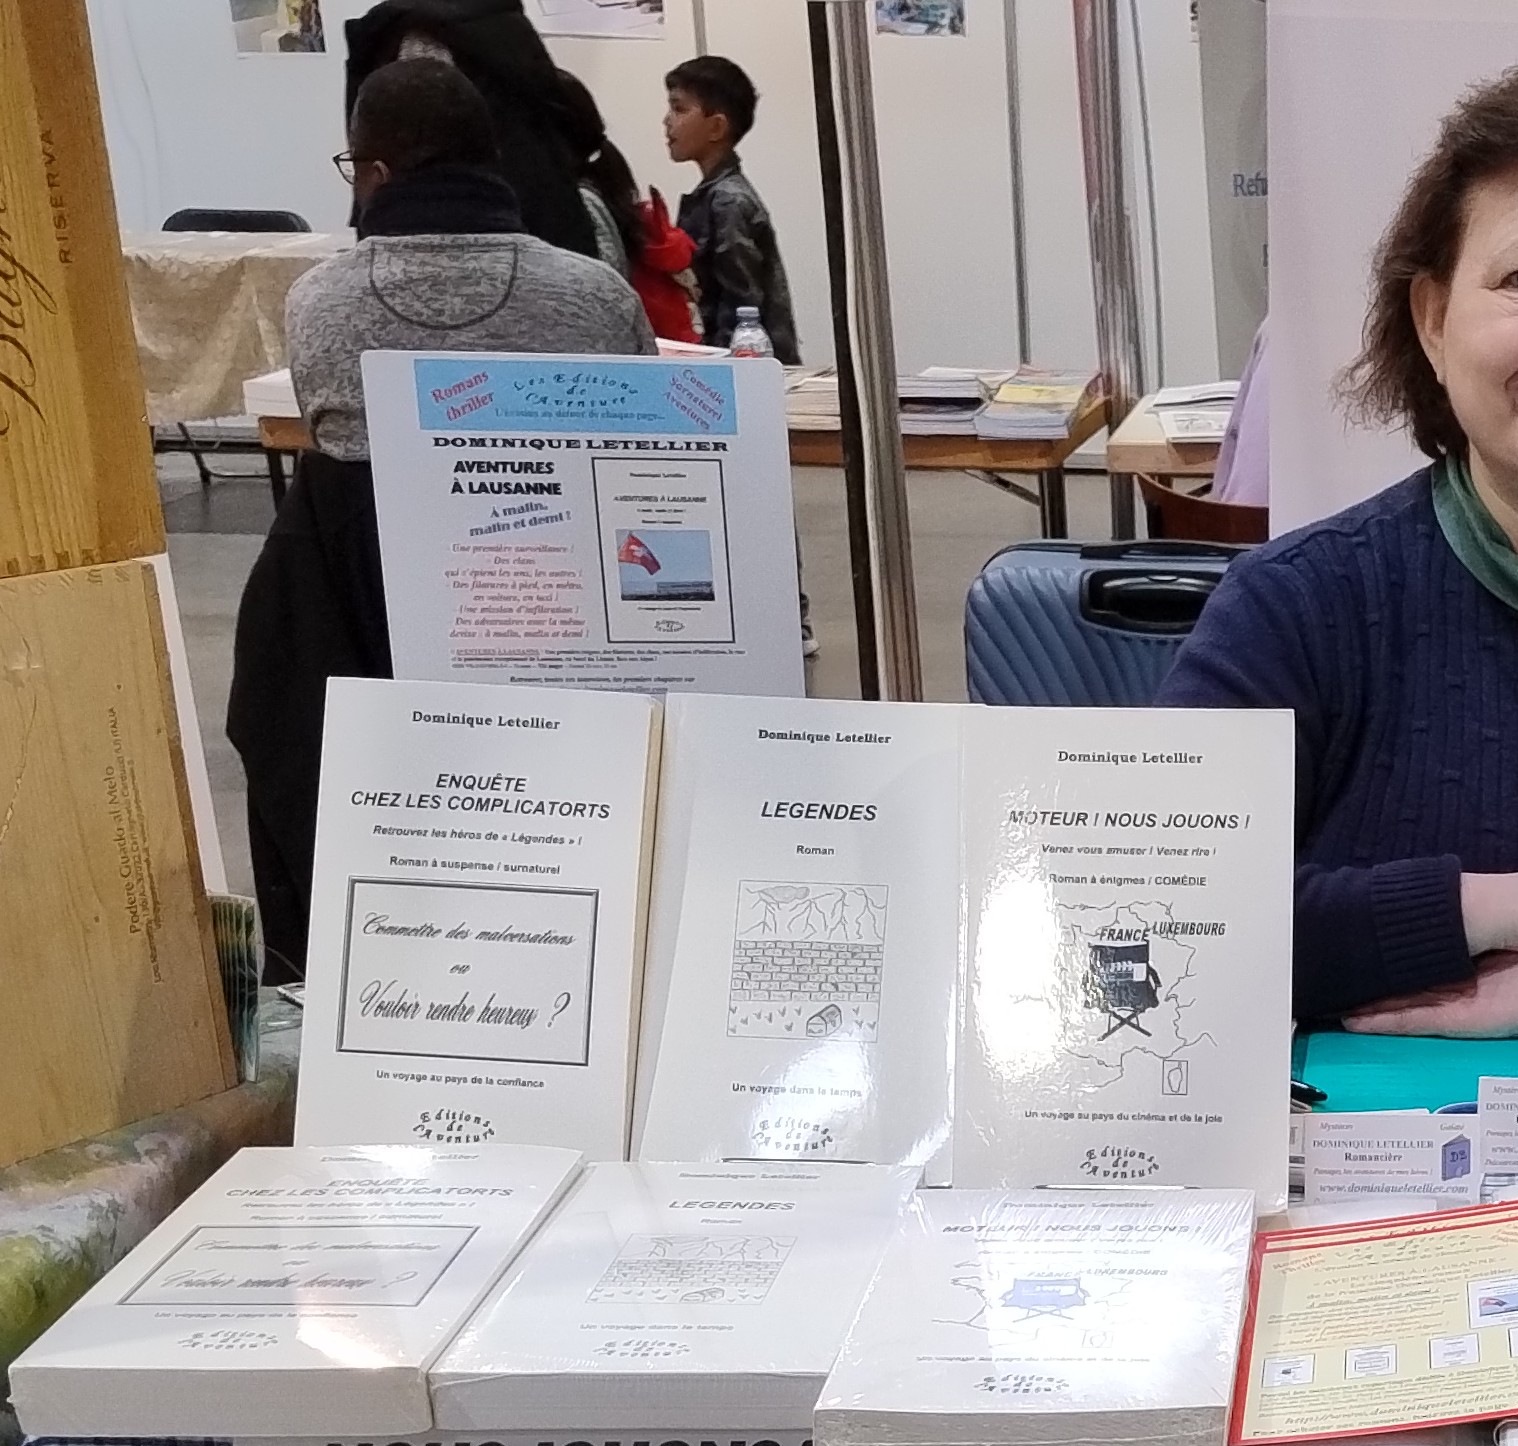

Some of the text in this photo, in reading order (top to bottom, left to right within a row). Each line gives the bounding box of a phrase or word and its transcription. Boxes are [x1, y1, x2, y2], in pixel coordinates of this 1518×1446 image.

[431, 370, 489, 404] Romans
[432, 437, 727, 451] DOMINIQUE LETELLIER
[453, 460, 554, 474] AVENTURES
[450, 476, 562, 495] À LAUSANNE
[412, 710, 560, 729] Dominique Letellier
[758, 728, 891, 743] Dominique Letellier
[1057, 750, 1202, 765] Dominique Letellier
[435, 772, 526, 792] ENQUÊTE
[350, 790, 610, 818] CHEZ LES COMPLICATORTS
[760, 801, 877, 821] LEGENDES
[1008, 810, 1088, 826] MOTEUR
[1104, 812, 1157, 827] NOUS
[1161, 813, 1239, 829] JOUONS
[796, 844, 834, 855] Roman
[389, 855, 428, 867] Roman
[431, 857, 437, 867] à
[440, 860, 494, 871] suspense
[503, 864, 560, 874] surnaturel
[1098, 926, 1150, 943] FRANCE
[1152, 920, 1226, 938] LUXEMBOURG
[1312, 1139, 1433, 1149] DOMINIQUE LETELLIER
[1319, 1182, 1468, 1193] www.dominiqueletellier.com
[668, 1200, 795, 1210] LEGENDES
